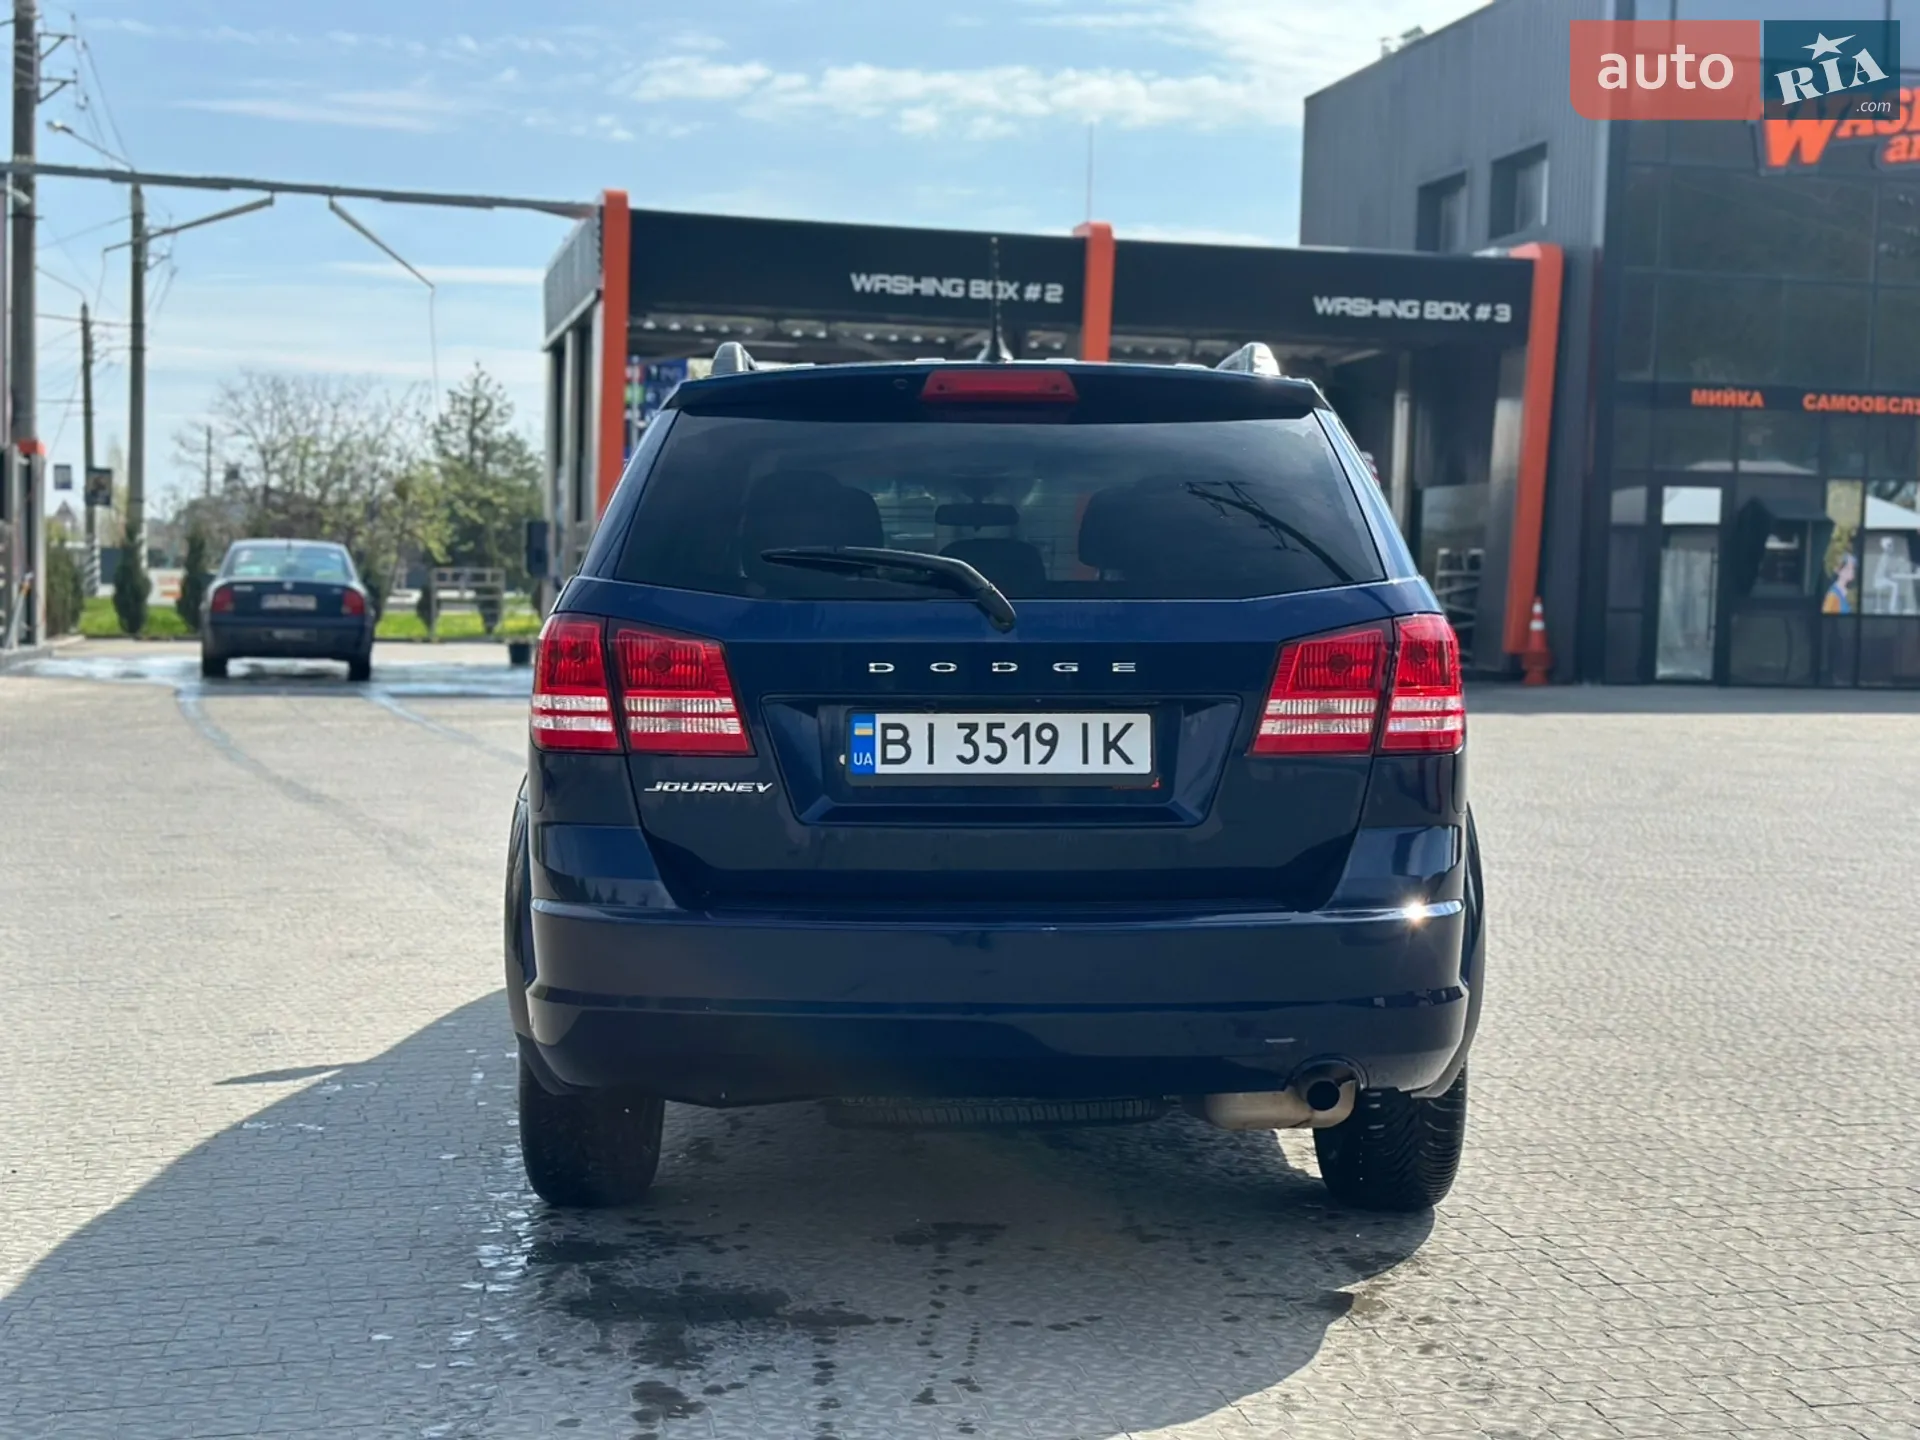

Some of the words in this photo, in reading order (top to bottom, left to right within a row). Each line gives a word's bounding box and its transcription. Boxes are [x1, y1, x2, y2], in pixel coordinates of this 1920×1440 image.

[850, 272, 965, 297] WASHING
[969, 278, 1019, 301] BOX
[1313, 295, 1420, 319] WASHING
[1423, 300, 1470, 321] BOX
[1691, 387, 1764, 408] МИЙКА
[868, 662, 1136, 673] DODGE
[853, 752, 873, 766] UA
[880, 722, 935, 766] BI
[955, 722, 1059, 766] 3519
[1081, 722, 1135, 766] IK
[644, 781, 773, 793] JOURNEY
